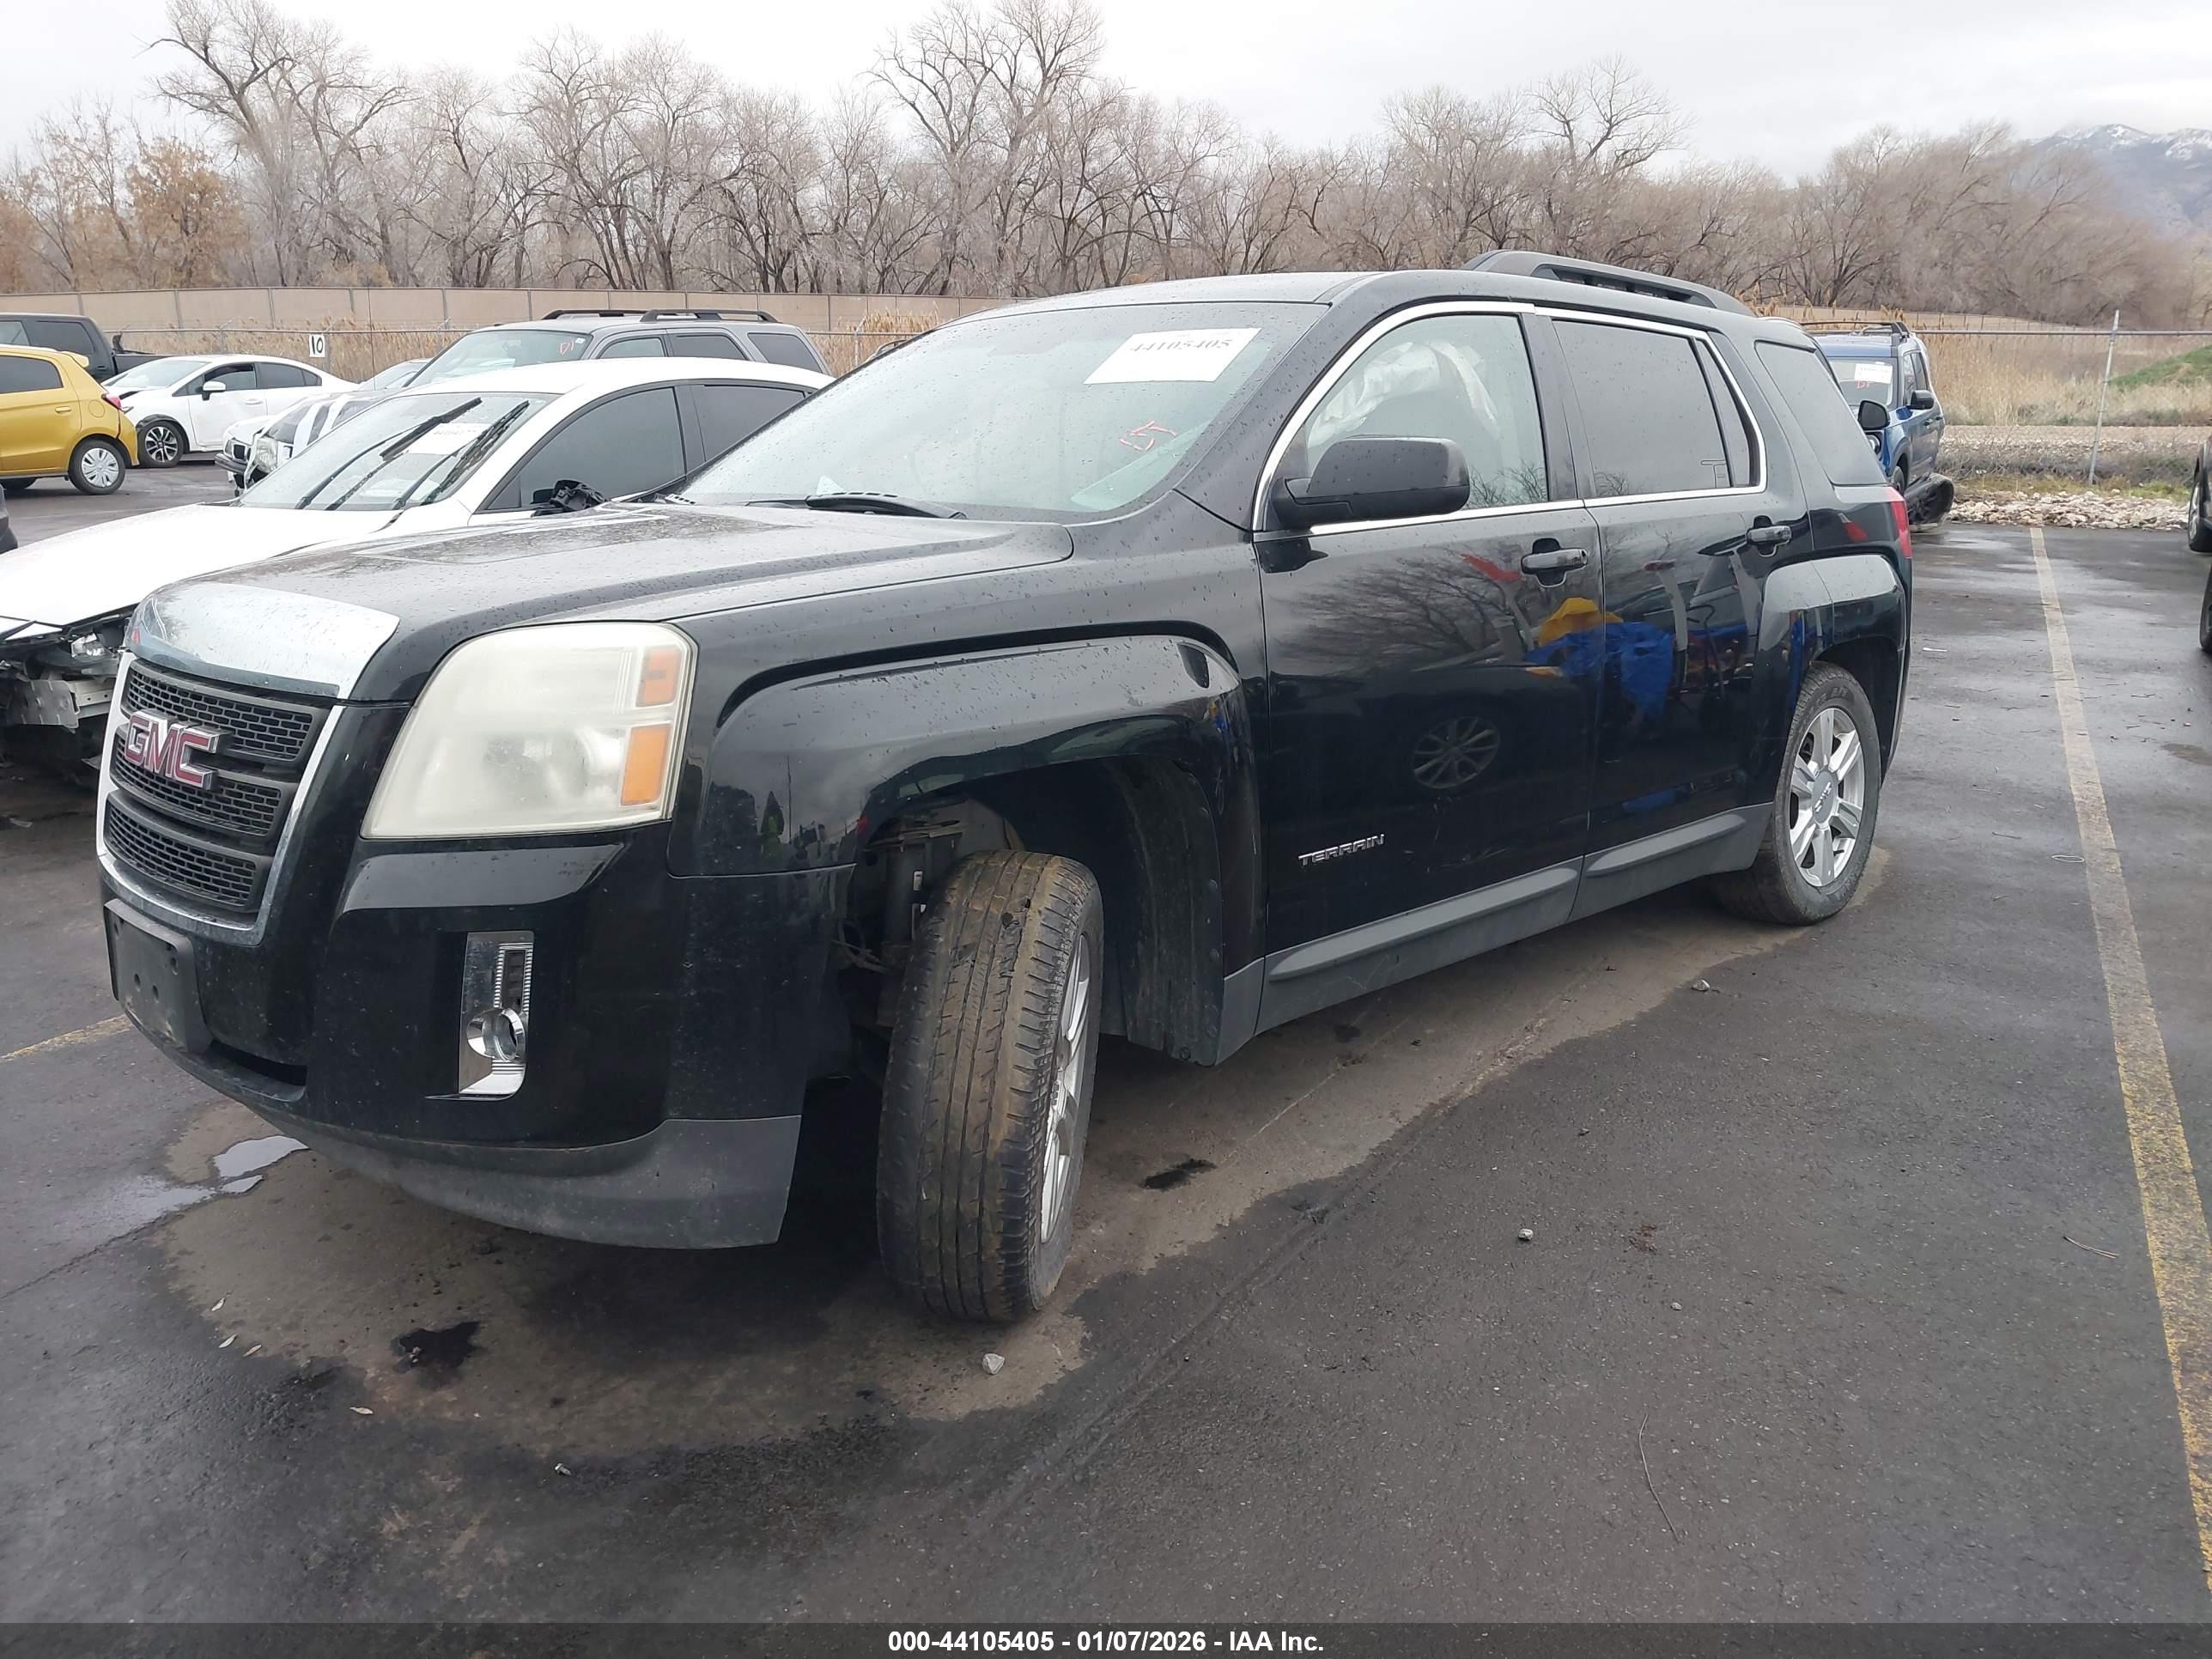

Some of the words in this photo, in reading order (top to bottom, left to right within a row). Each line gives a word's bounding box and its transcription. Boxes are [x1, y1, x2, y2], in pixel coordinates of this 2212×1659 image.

[311, 335, 324, 355] 10
[1130, 338, 1233, 352] 44105405
[124, 708, 220, 790] GMC
[1297, 833, 1385, 866] TERRAIN
